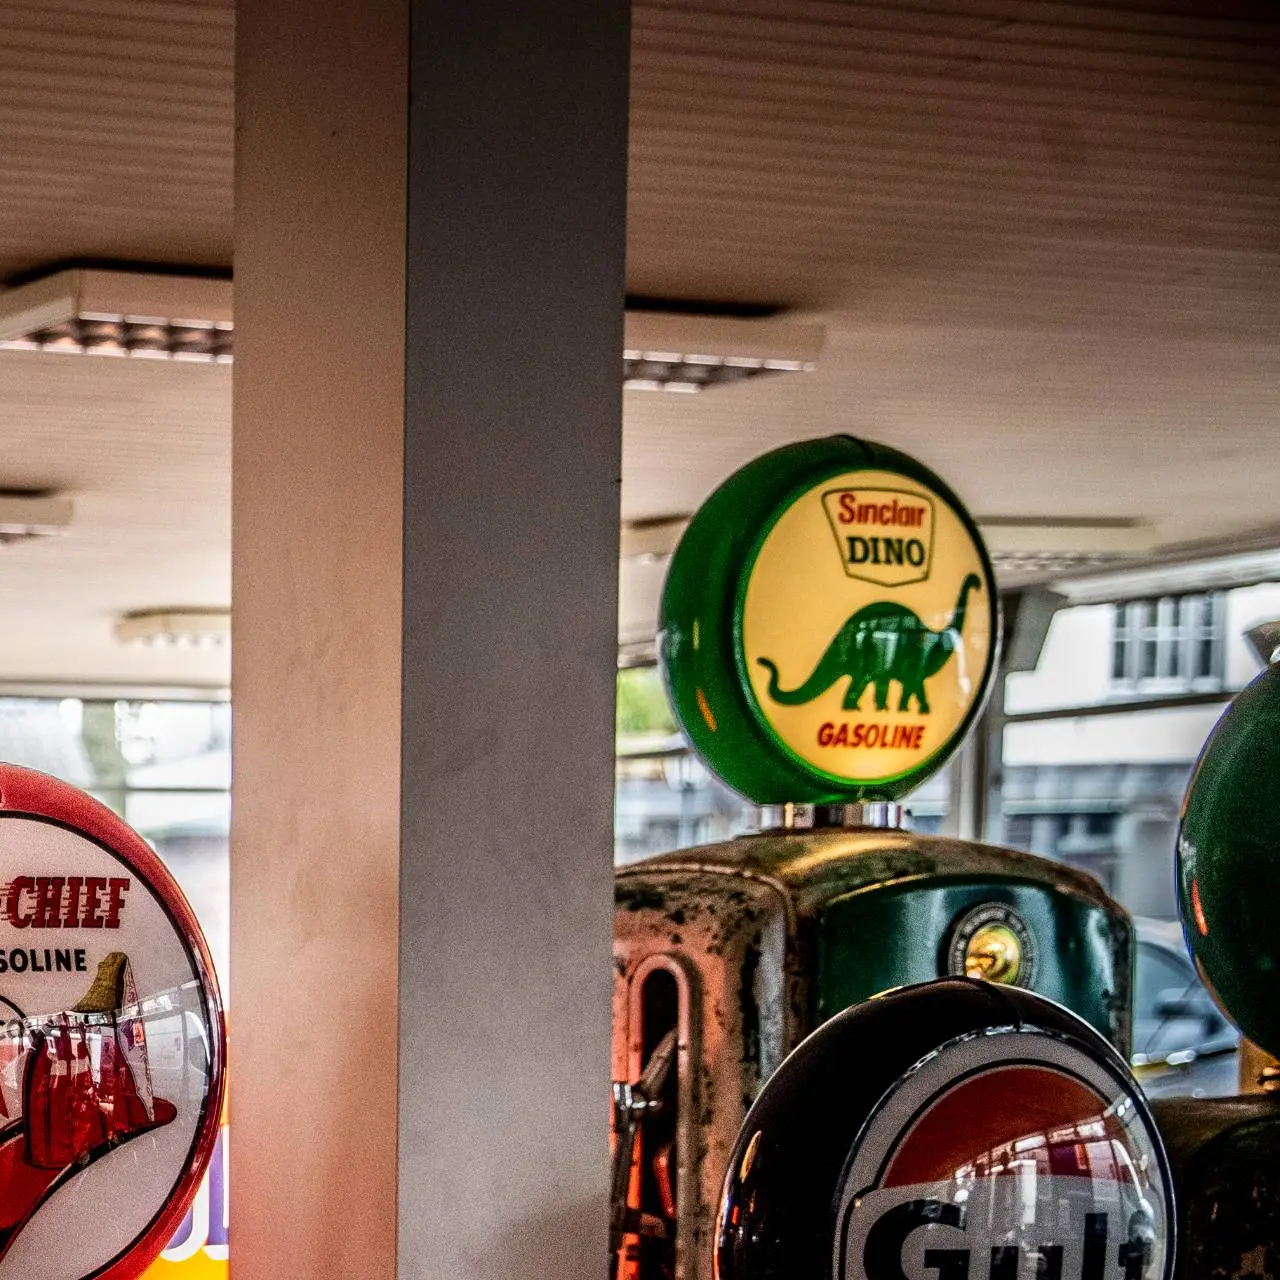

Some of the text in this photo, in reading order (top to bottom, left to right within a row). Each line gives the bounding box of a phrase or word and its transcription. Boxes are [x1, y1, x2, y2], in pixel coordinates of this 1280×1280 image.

[838, 493, 927, 528] Sinclair
[846, 535, 925, 567] DINO
[817, 722, 925, 749] GASOLINE
